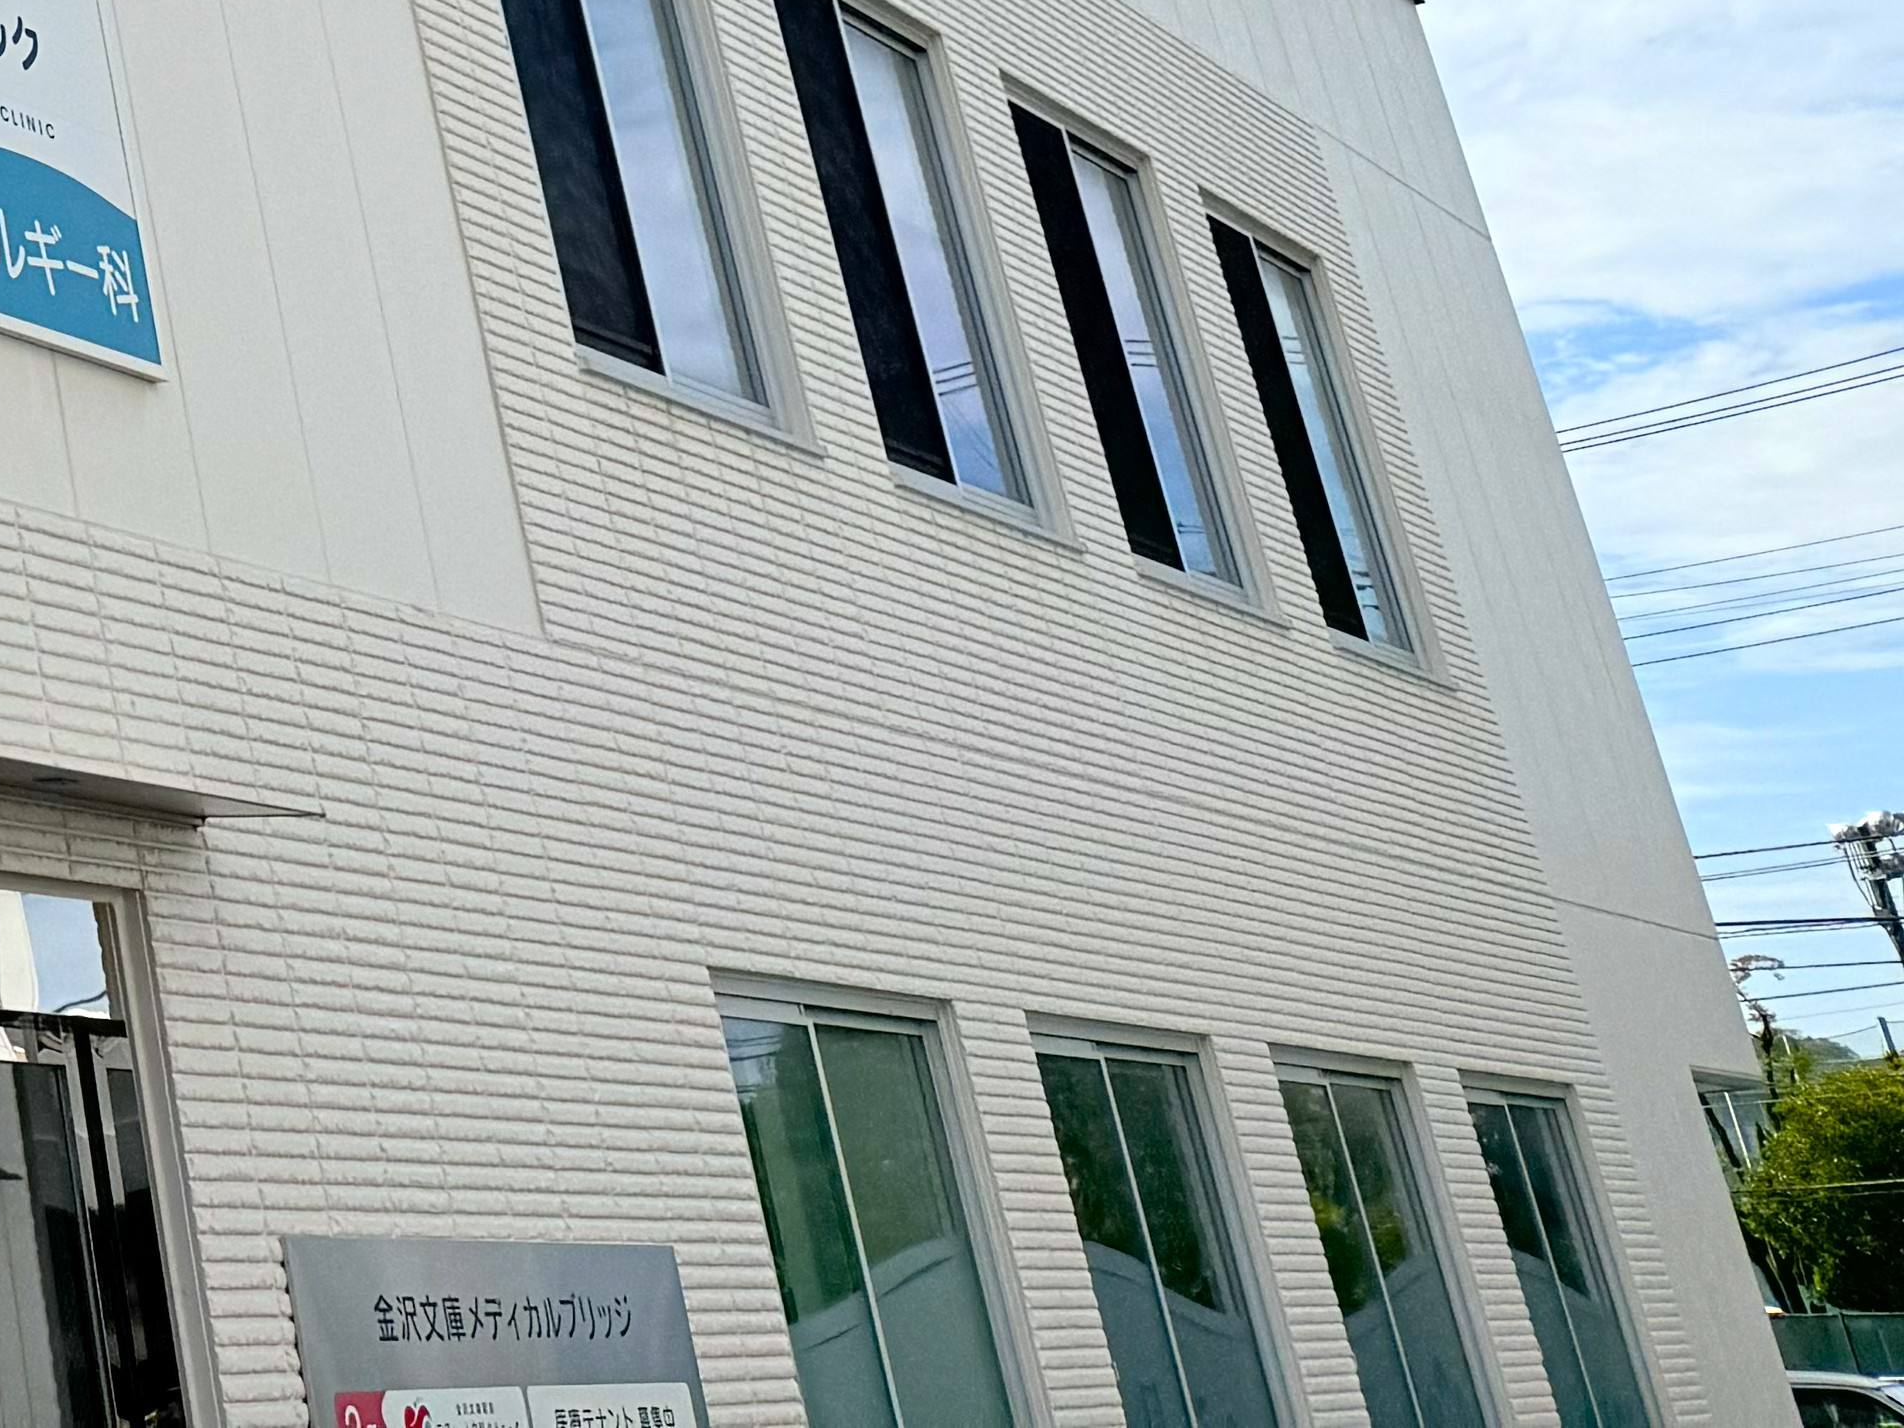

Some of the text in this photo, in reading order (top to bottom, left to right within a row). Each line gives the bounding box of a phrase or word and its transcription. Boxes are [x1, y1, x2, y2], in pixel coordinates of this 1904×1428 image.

[0, 106, 56, 140] CLINIC
[374, 1294, 632, 1342] 金沢文庫メディカルブリッジ
